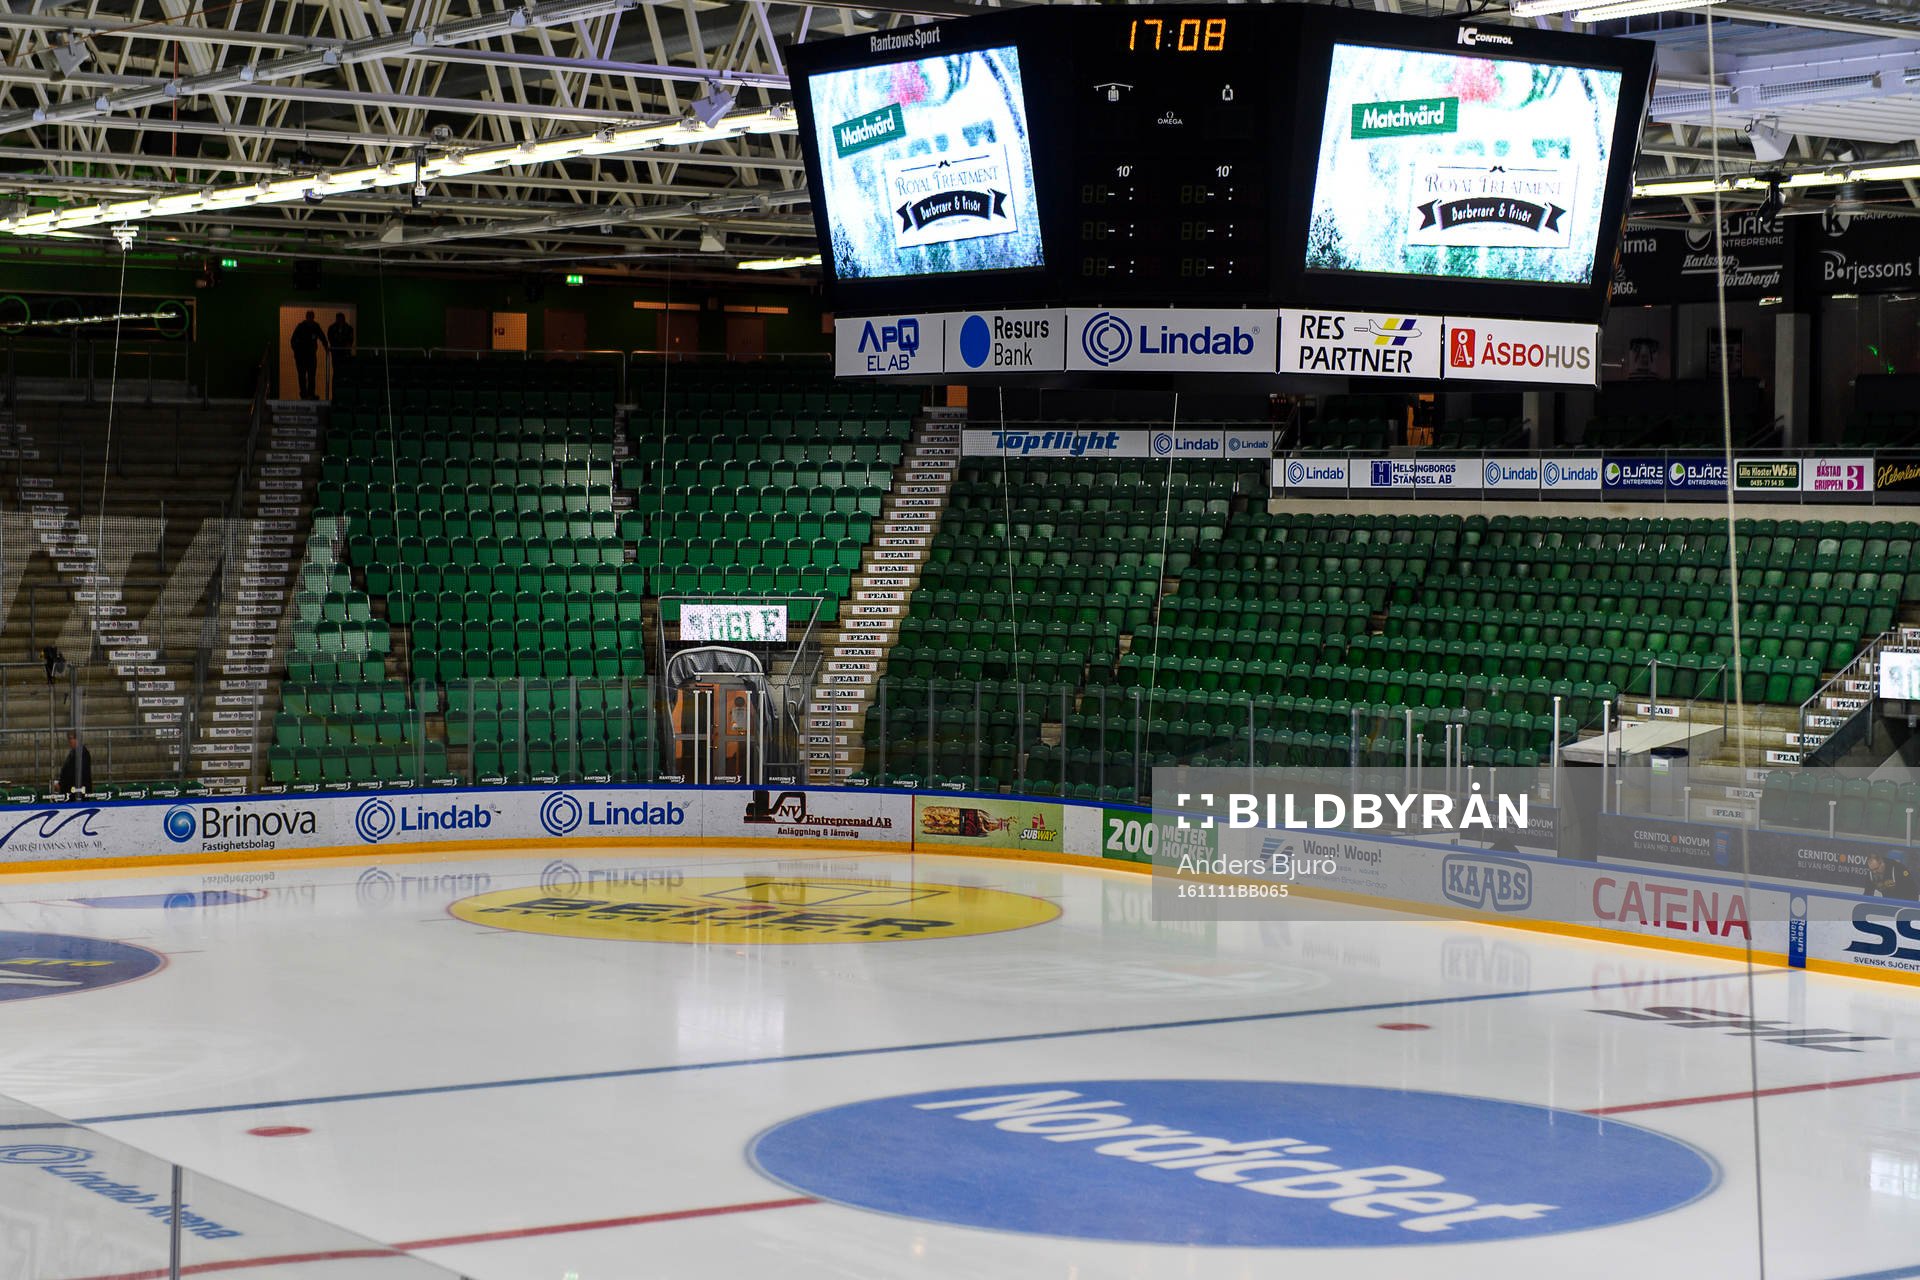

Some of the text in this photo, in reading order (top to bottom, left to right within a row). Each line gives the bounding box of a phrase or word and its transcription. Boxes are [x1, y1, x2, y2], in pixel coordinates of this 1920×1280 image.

[870, 27, 940, 52] Rantzows Sport
[1130, 18, 1227, 51] 17:08
[1475, 34, 1513, 45] CONTROL
[1362, 102, 1444, 130] Matchvärd
[840, 109, 895, 148] Matchvärd
[932, 167, 998, 190] TREATMENT
[1499, 202, 1505, 218] &
[994, 316, 1050, 340] Resurs
[1300, 315, 1346, 340] RES
[994, 342, 1033, 366] Bank
[1300, 345, 1412, 374] PARTNER
[1480, 338, 1590, 370] ÅSBOHUS
[992, 432, 1120, 455] Topflight
[1175, 438, 1219, 450] Lindab
[1241, 440, 1269, 449] Lindab
[1306, 466, 1344, 480] Lindab
[1392, 463, 1456, 474] HELSINGBORGS
[1502, 467, 1538, 481] Lindab
[1561, 467, 1598, 481] Lindab
[1623, 464, 1664, 478] BJÄRE
[1688, 464, 1729, 478] BJÄRE
[1392, 474, 1452, 485] STÄNGSEL AB
[1814, 480, 1844, 490] GRUPPEN
[202, 805, 316, 839] Brinova
[401, 804, 492, 831] Lindab
[588, 801, 685, 826] Lindab
[806, 814, 873, 828] Entreprenad
[874, 816, 892, 828] AB
[778, 826, 820, 838] Anläggning
[830, 828, 859, 839] Järnväg
[1020, 829, 1056, 842] SUBWAY
[1106, 818, 1160, 856] 200
[1162, 825, 1208, 846] METER
[1634, 830, 1710, 848] CERNITOL NOVUM
[202, 840, 275, 852] Fastighetsbolag
[1162, 841, 1214, 861] HOCKEY
[1302, 840, 1382, 866] Woop! Woop!
[1798, 849, 1868, 866] CERNITOL NOV
[1851, 867, 1868, 876] PROS
[1448, 864, 1526, 901] KAABS
[502, 897, 954, 932] BEIJER
[1592, 877, 1752, 940] CATENA
[1854, 956, 1886, 967] SVENSK
[912, 1090, 1562, 1232] NordicBet
[42, 1164, 159, 1204] Lindab
